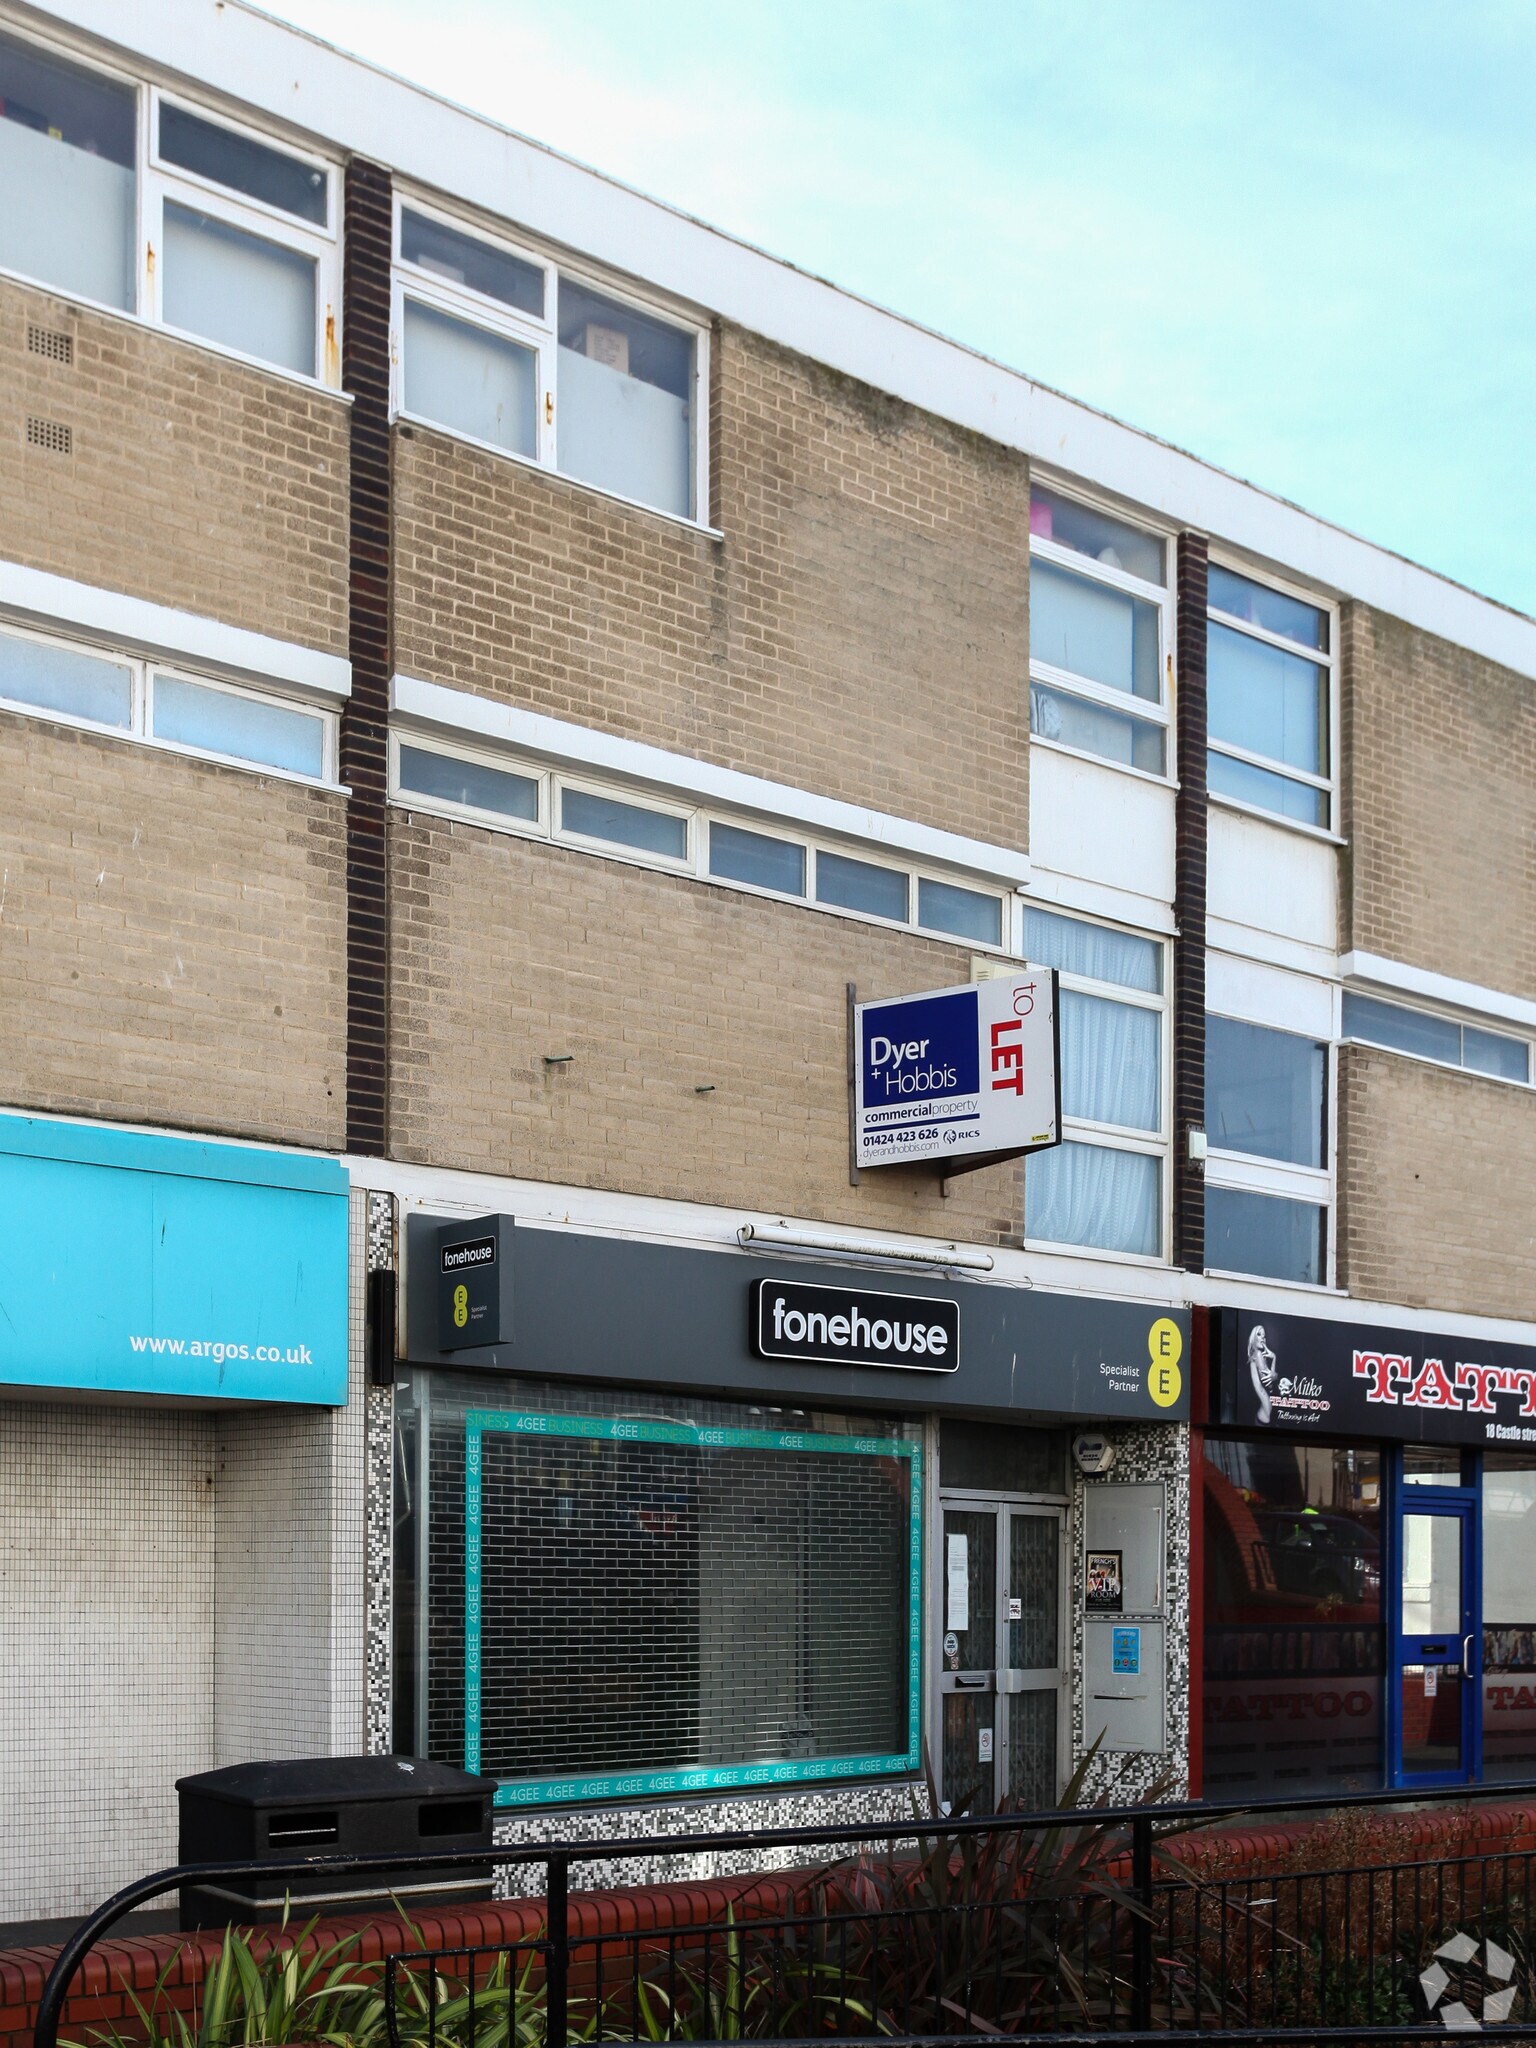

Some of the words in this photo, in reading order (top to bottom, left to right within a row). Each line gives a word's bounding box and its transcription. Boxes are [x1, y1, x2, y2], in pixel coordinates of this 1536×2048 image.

[1012, 982, 1037, 1016] to
[870, 1036, 930, 1069] Dyer
[990, 1019, 1024, 1096] LET
[871, 1068, 881, 1080] +
[886, 1063, 957, 1095] Hobbis
[863, 1133, 894, 1147] 01424
[896, 1131, 916, 1143] 423
[918, 1128, 939, 1140] 626
[863, 1141, 940, 1159] dyerandhobbis.com
[958, 1130, 980, 1139] RICS
[444, 1246, 492, 1266] fonehouse
[773, 1297, 948, 1355] fonehouse
[129, 1335, 313, 1365] www.argos.co.uk
[1099, 1363, 1140, 1377] Specialist
[1109, 1379, 1140, 1392] Partner
[1270, 1396, 1330, 1411] TATTOO
[516, 1416, 547, 1431] 4GEE
[549, 1419, 603, 1436] BUSINESS
[611, 1424, 638, 1438] 4GEE
[640, 1427, 691, 1442] BUSINESS
[698, 1430, 724, 1444] 4GEE
[779, 1435, 803, 1448] 4GEE
[854, 1440, 877, 1453] 4GEE
[1485, 1423, 1495, 1438] 18
[1496, 1424, 1521, 1440] Castle
[468, 1435, 479, 1475] 4GEE
[912, 1446, 920, 1479] 4GEE
[468, 1485, 479, 1525] 4GEE
[468, 1534, 479, 1574] 4GEE
[911, 1568, 919, 1601] 4GEE
[1090, 1591, 1116, 1599] ROOM
[468, 1583, 479, 1624] 4GEE
[911, 1609, 919, 1642] 4GEE
[468, 1633, 479, 1673] 4GEE
[468, 1682, 479, 1722] 4GEE
[1487, 1686, 1536, 1710] TA
[468, 1732, 479, 1772] 4GEE
[910, 1731, 918, 1764] 4GEE
[510, 1787, 540, 1802] 4GEE
[546, 1785, 575, 1799] 4GEE
[581, 1782, 610, 1796] 4GEE
[615, 1779, 643, 1793] 4GEE
[649, 1776, 675, 1790] 4GEE
[682, 1774, 708, 1787] 4GEE
[713, 1771, 738, 1784] 4GEE
[744, 1769, 769, 1782] 4GEE
[774, 1766, 798, 1779] 4GEE
[803, 1764, 826, 1777] 4GEE
[831, 1761, 854, 1774] 4GEE
[859, 1760, 881, 1772] 4GEE
